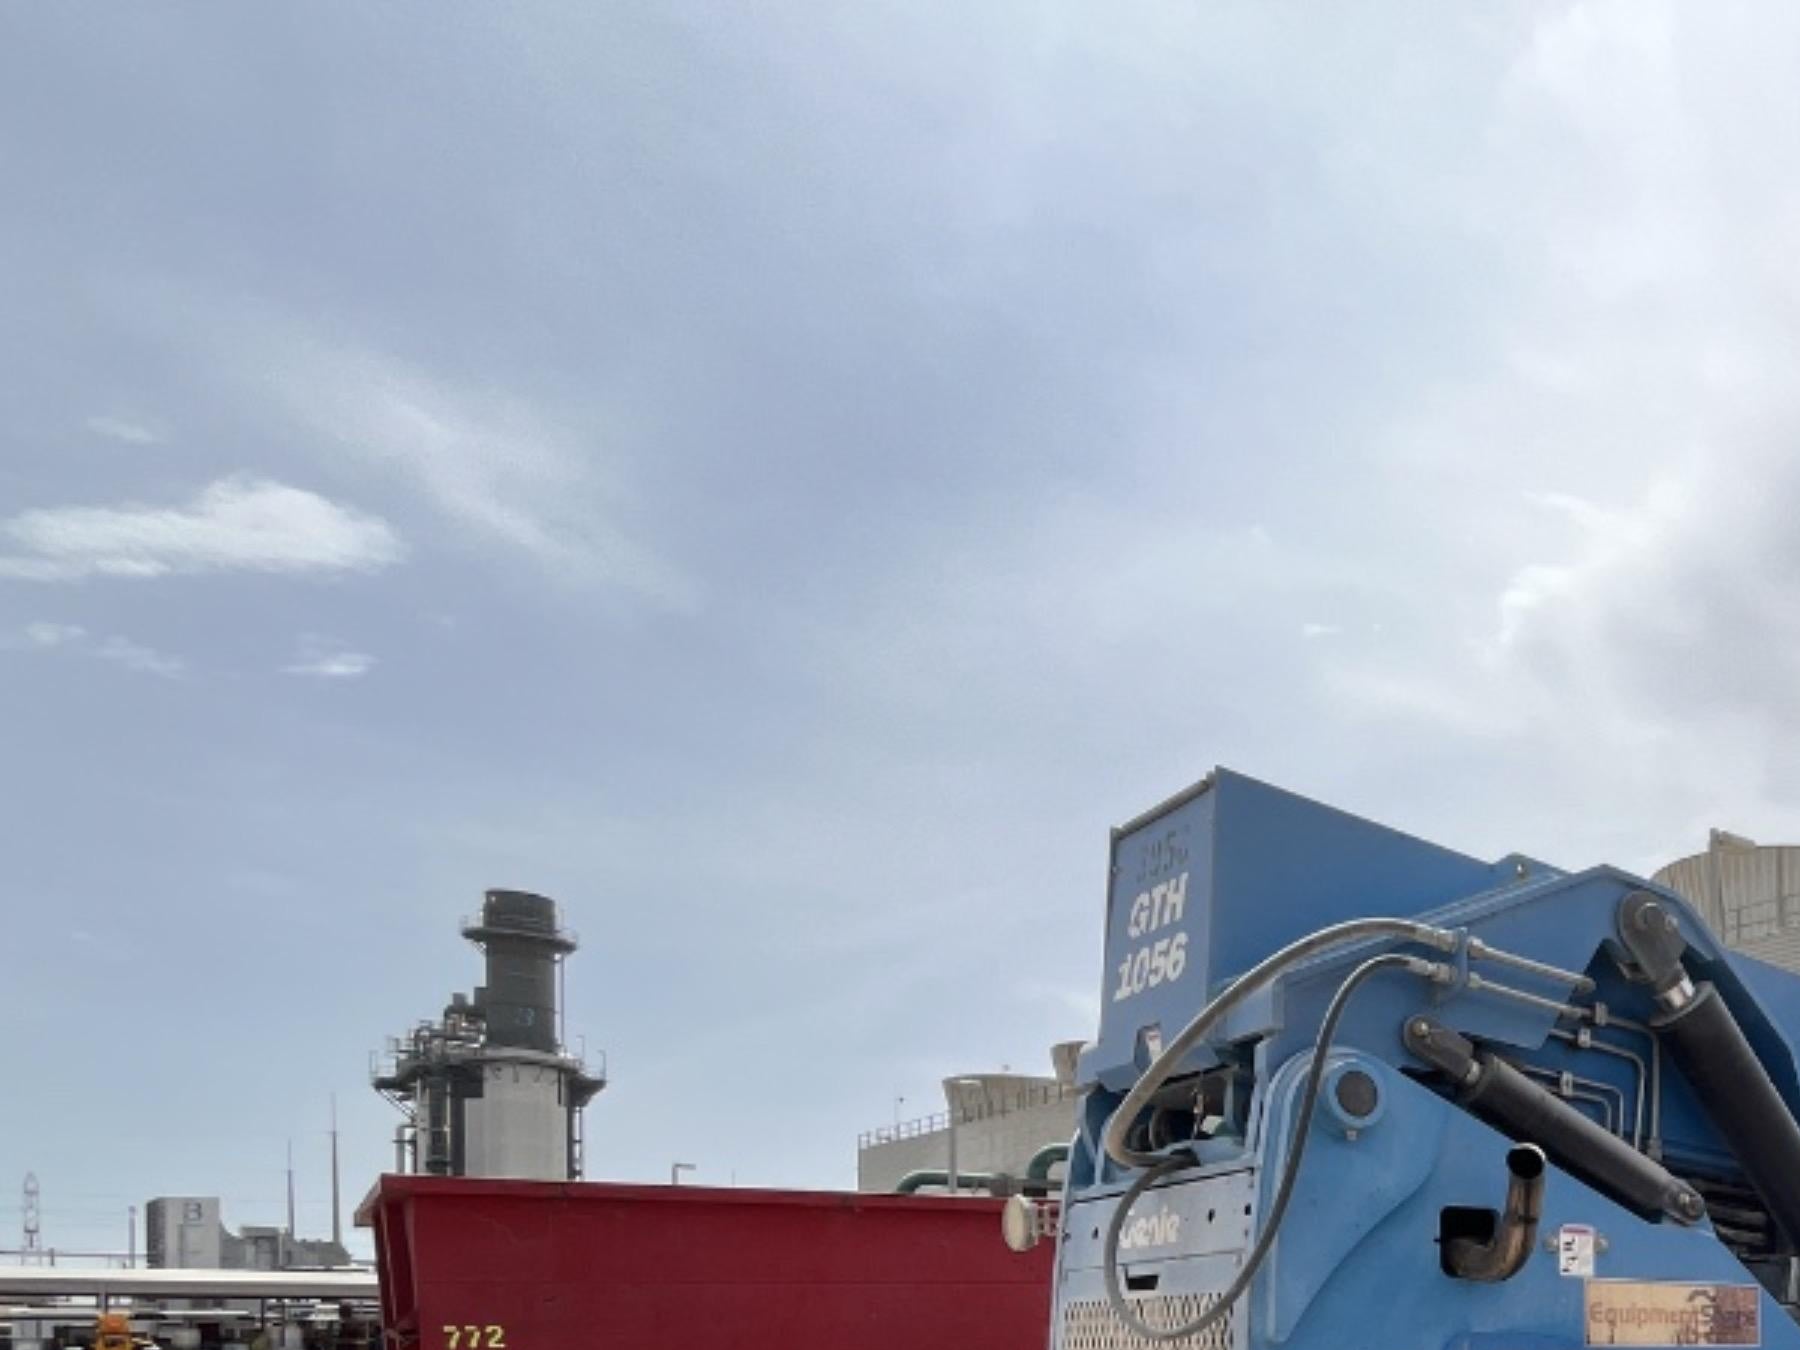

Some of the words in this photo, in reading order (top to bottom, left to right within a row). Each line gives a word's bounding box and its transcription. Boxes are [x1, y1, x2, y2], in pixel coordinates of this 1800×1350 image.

[1128, 872, 1189, 939] GTH
[1113, 932, 1189, 1002] 1056
[443, 1325, 506, 1350] 772
